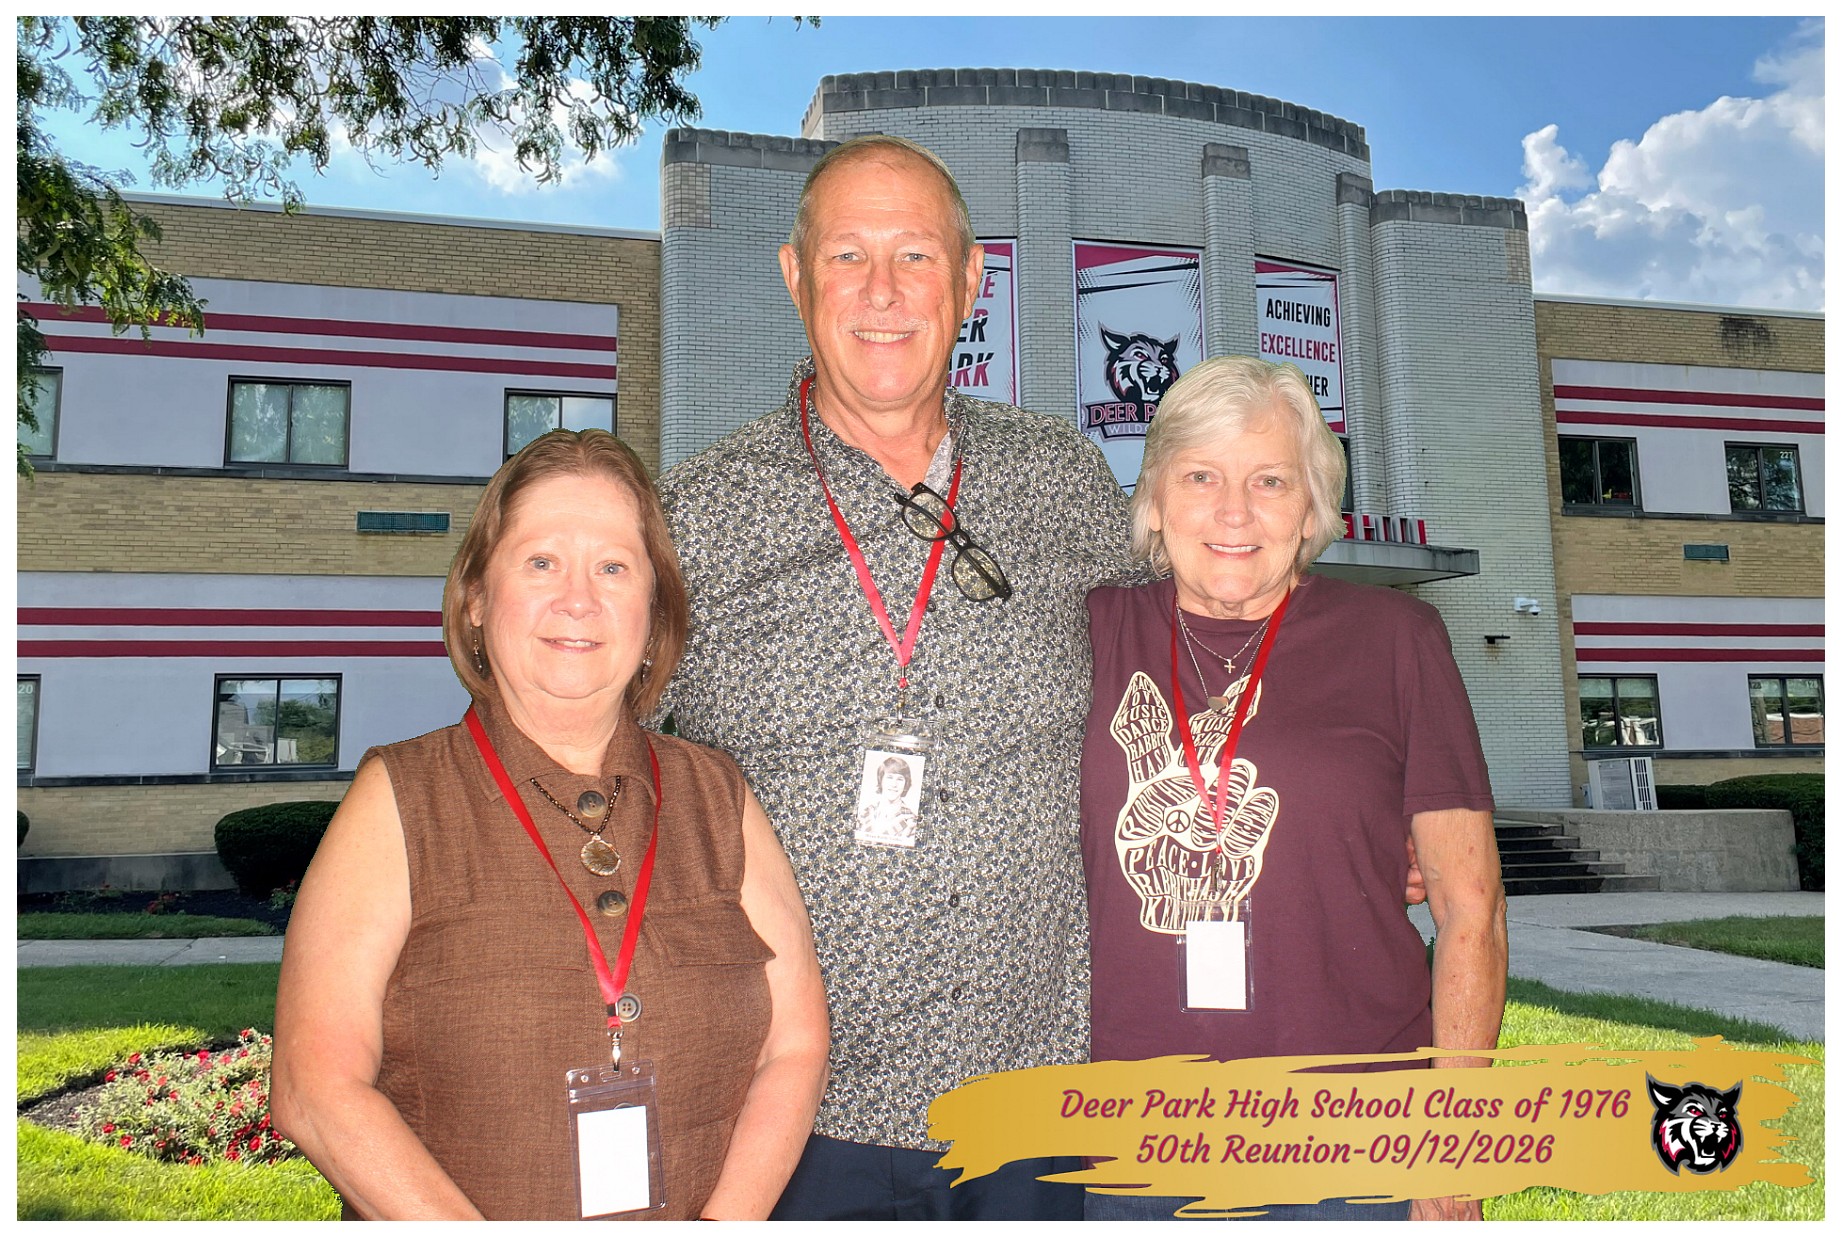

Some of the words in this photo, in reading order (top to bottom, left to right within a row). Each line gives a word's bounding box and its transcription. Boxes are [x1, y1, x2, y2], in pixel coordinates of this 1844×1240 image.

[1266, 298, 1331, 327] ACHIEVING
[1261, 332, 1336, 363] EXCELLENCE
[1090, 403, 1139, 425] DEER
[1115, 704, 1167, 730] MUSIC
[1117, 719, 1168, 744] DANCE
[1128, 732, 1166, 761] RABBIT
[1132, 745, 1170, 782] HASH
[1128, 836, 1190, 877] PEACE
